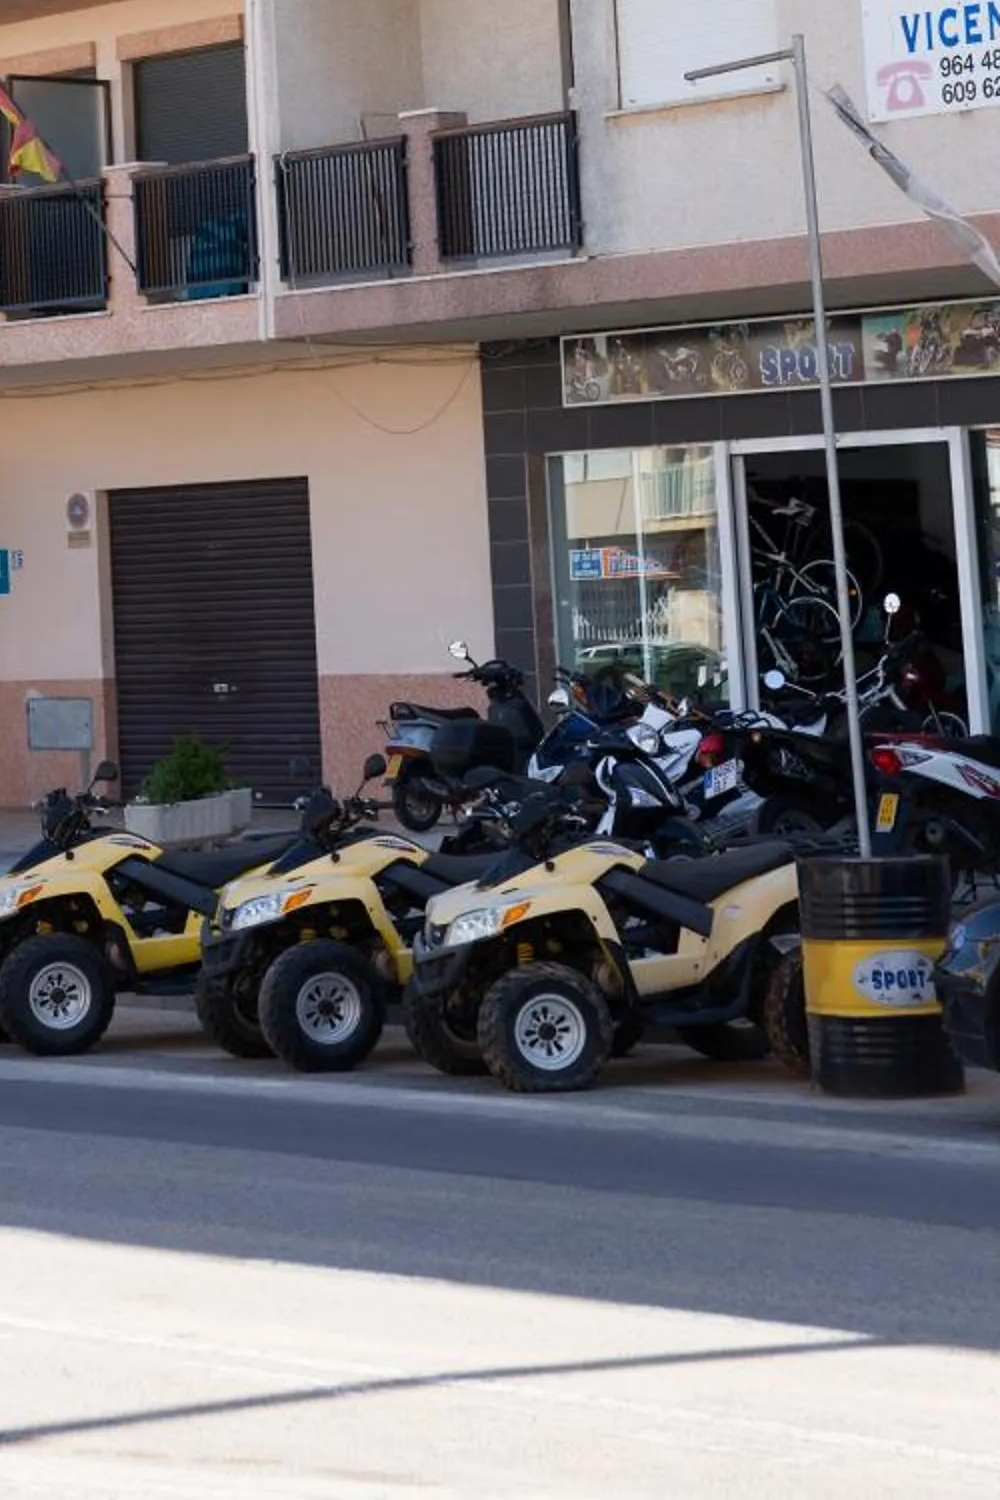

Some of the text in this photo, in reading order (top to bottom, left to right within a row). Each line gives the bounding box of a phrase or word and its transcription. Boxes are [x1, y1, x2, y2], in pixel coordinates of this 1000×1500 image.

[900, 0, 1000, 53] VICEN
[939, 48, 1000, 77] 964 48
[941, 79, 977, 104] 609
[871, 968, 926, 991] SPORT
